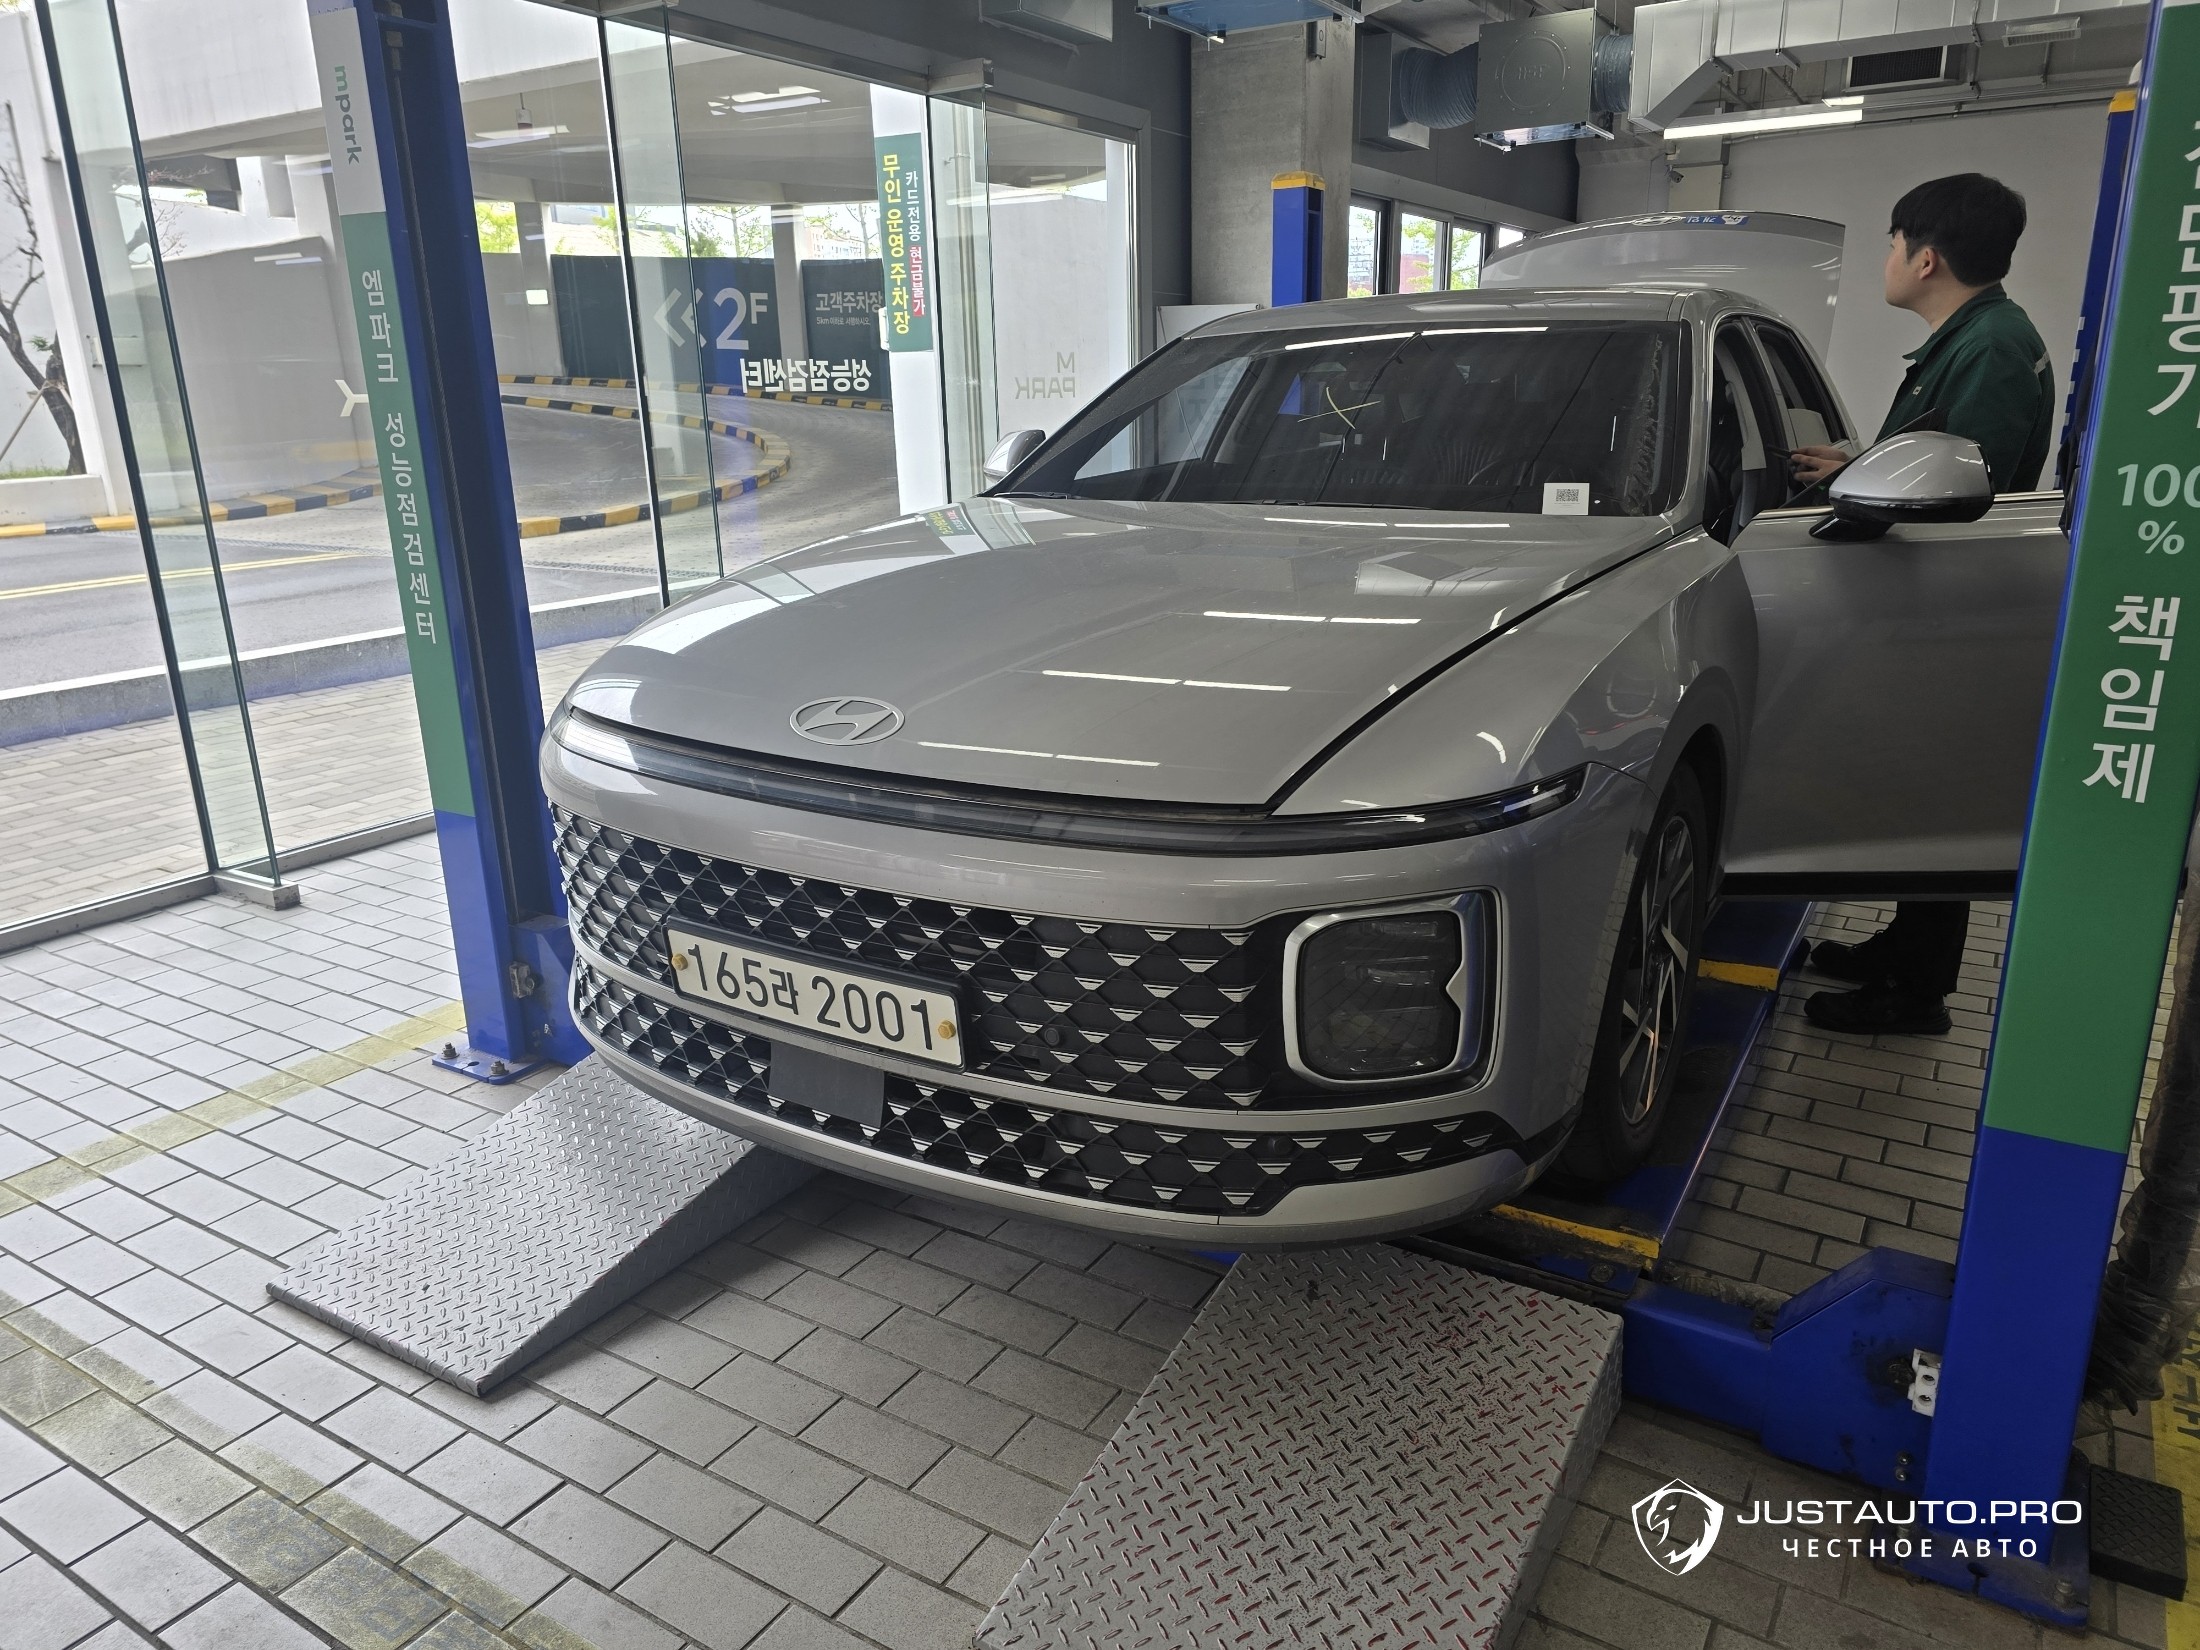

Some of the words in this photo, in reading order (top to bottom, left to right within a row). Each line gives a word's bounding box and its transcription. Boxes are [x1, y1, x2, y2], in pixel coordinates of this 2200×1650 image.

[334, 65, 362, 165] mpark
[883, 154, 901, 204] 무인
[905, 170, 921, 242] 카드전용
[886, 209, 904, 258] 운영
[815, 291, 883, 313] 고객주차장
[890, 263, 910, 334] 주차장
[909, 246, 925, 315] 현금불가
[713, 287, 768, 350] 2F
[362, 269, 399, 383] 엠파크
[385, 412, 437, 645] 성능점검센터
[2138, 520, 2185, 555] %
[2082, 595, 2181, 804] 책임제
[687, 943, 799, 1015] 165라
[811, 975, 933, 1051] 2001
